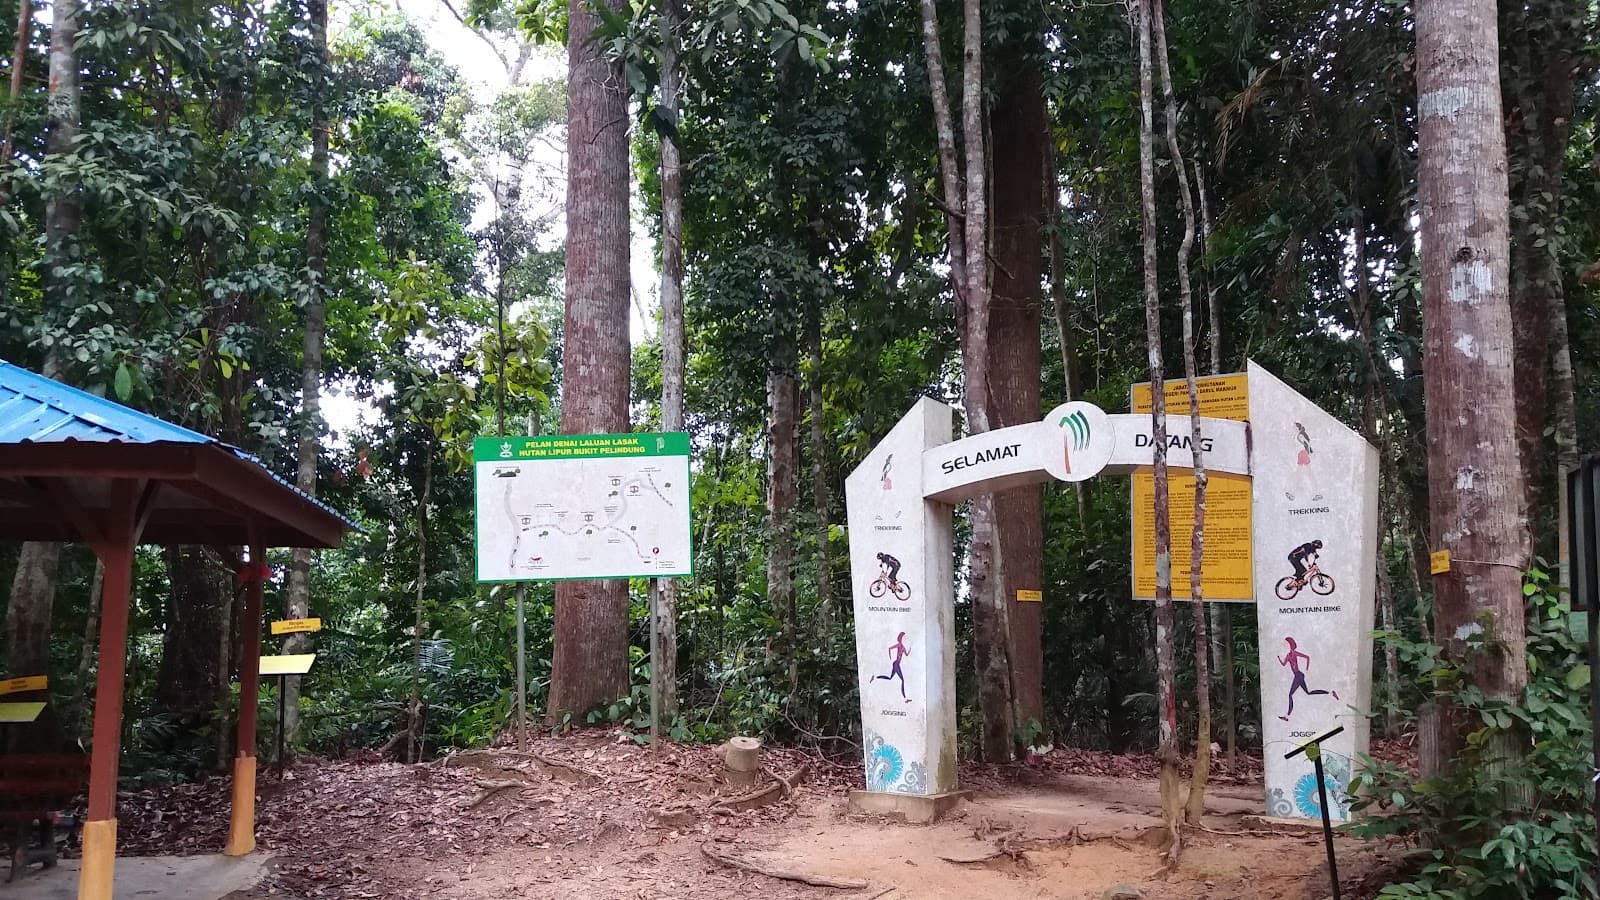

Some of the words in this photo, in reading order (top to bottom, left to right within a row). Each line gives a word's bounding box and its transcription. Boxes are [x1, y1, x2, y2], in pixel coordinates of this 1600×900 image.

[579, 439, 611, 447] LALUAN
[612, 438, 639, 446] LASAK
[1135, 434, 1214, 452] DANG
[519, 449, 547, 457] HUTAN
[548, 448, 572, 456] LIPUR
[573, 447, 598, 455] BUKIT
[599, 446, 646, 454] PELINDUNG
[941, 444, 1022, 475] SELAMAT
[1288, 506, 1330, 515] TREKKING
[1279, 606, 1322, 614] MOUNTAIN
[1323, 605, 1341, 613] BIKE
